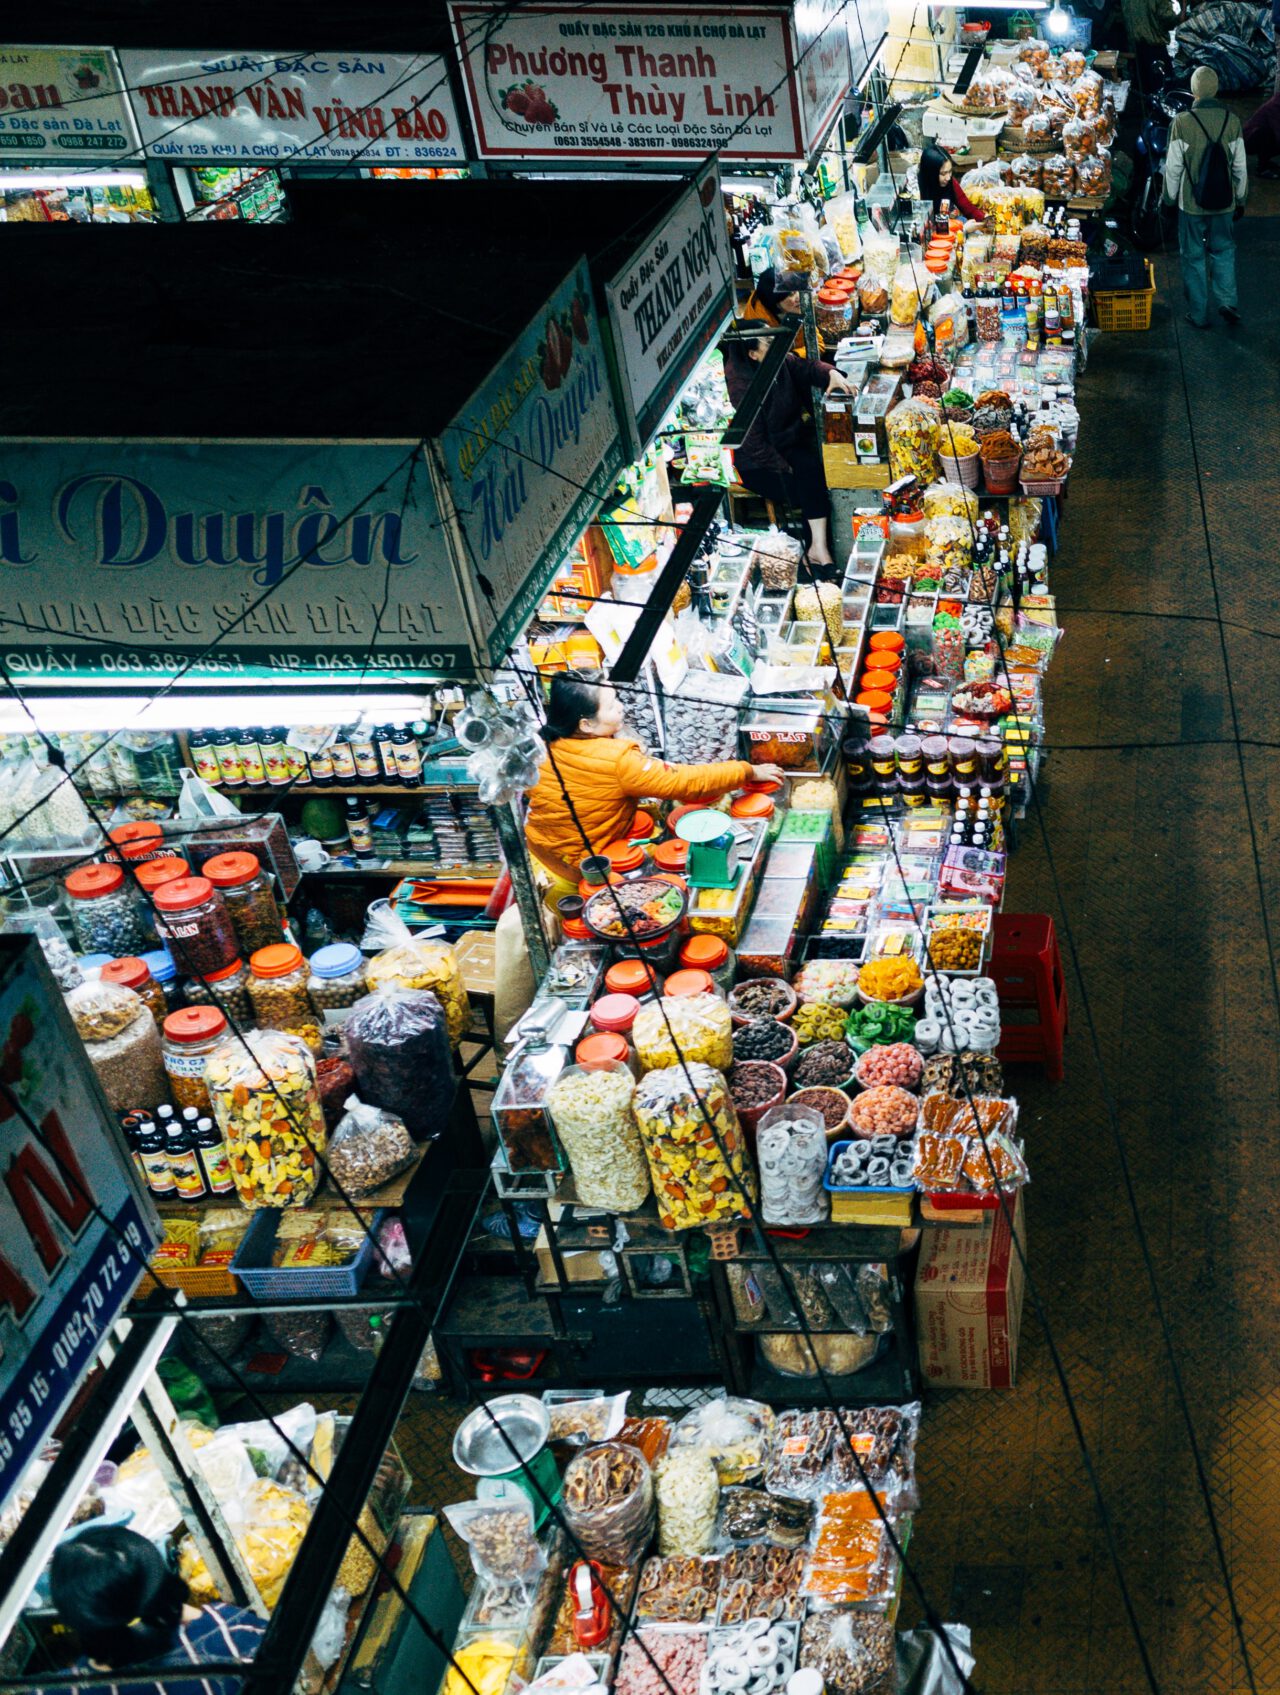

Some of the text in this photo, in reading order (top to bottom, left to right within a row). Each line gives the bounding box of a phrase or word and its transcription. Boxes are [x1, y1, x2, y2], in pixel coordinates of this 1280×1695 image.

[644, 25, 665, 37] 126
[693, 25, 701, 37] A
[338, 57, 386, 74] SẢN
[488, 43, 717, 83] Phương Thanh
[138, 77, 307, 119] THANH VÂN
[602, 83, 685, 122] Thùy
[703, 84, 775, 117] Linh
[312, 95, 449, 141] VĨNH BẢO
[554, 121, 576, 133] Bán
[591, 121, 608, 133] Và
[627, 122, 652, 133] Các
[656, 124, 679, 136] Loại
[683, 124, 707, 136] Đặc
[711, 123, 732, 134] Sản
[755, 125, 772, 137] Lạt
[187, 145, 208, 155] 125
[211, 145, 237, 155] KHU
[241, 145, 250, 155] A
[252, 144, 279, 158] CHỢ
[386, 146, 400, 157] ĐT
[415, 147, 457, 157] 836624
[633, 254, 685, 355] THANH
[680, 211, 718, 291] NGỌC
[53, 472, 419, 588] Duyên
[121, 597, 203, 641] ĐẶC
[306, 596, 363, 634] ĐÀ
[371, 603, 444, 641] LẠT
[103, 1259, 123, 1295] 72
